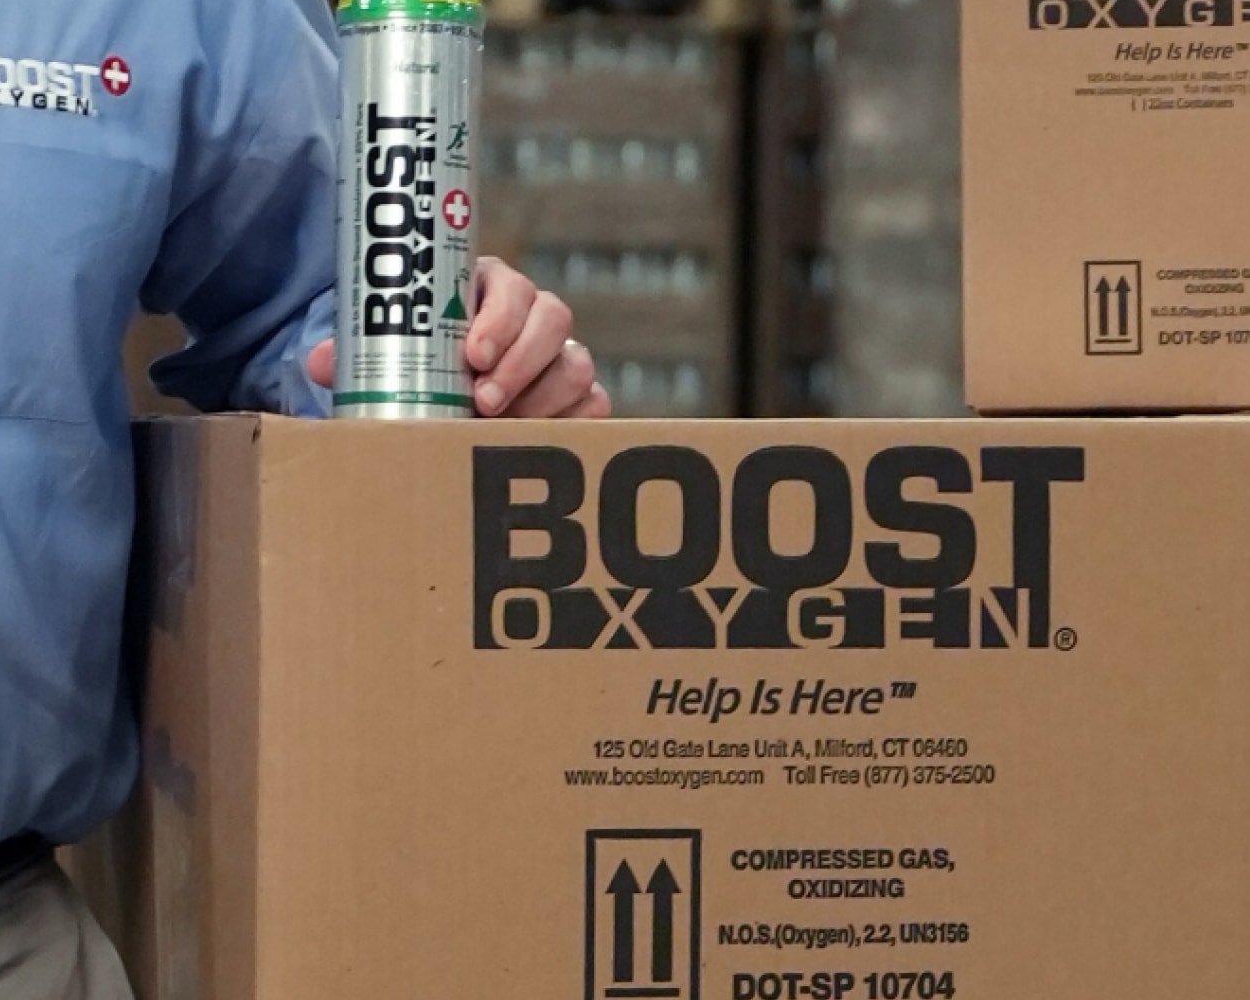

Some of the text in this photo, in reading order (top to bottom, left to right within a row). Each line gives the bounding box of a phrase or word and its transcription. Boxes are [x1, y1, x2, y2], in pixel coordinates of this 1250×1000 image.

[1115, 42, 1162, 64] Help
[1166, 43, 1182, 60] Is
[364, 102, 417, 337] BOOST
[1158, 331, 1221, 345] DOT-SP
[472, 445, 1085, 589] BOOST
[646, 677, 741, 723] Help
[750, 678, 780, 715] Is
[593, 738, 968, 761] 125 Old Gate Lane Unit A, Milford, CT 06460
[564, 765, 996, 789] www.boostoxygen.com Toll Free (877) 375-2500
[731, 848, 955, 873] COMPRESSED GAS,
[787, 878, 905, 900] OXIDIZING
[900, 922, 969, 944] UN3156
[732, 970, 956, 1000] DOT-SP 10704
